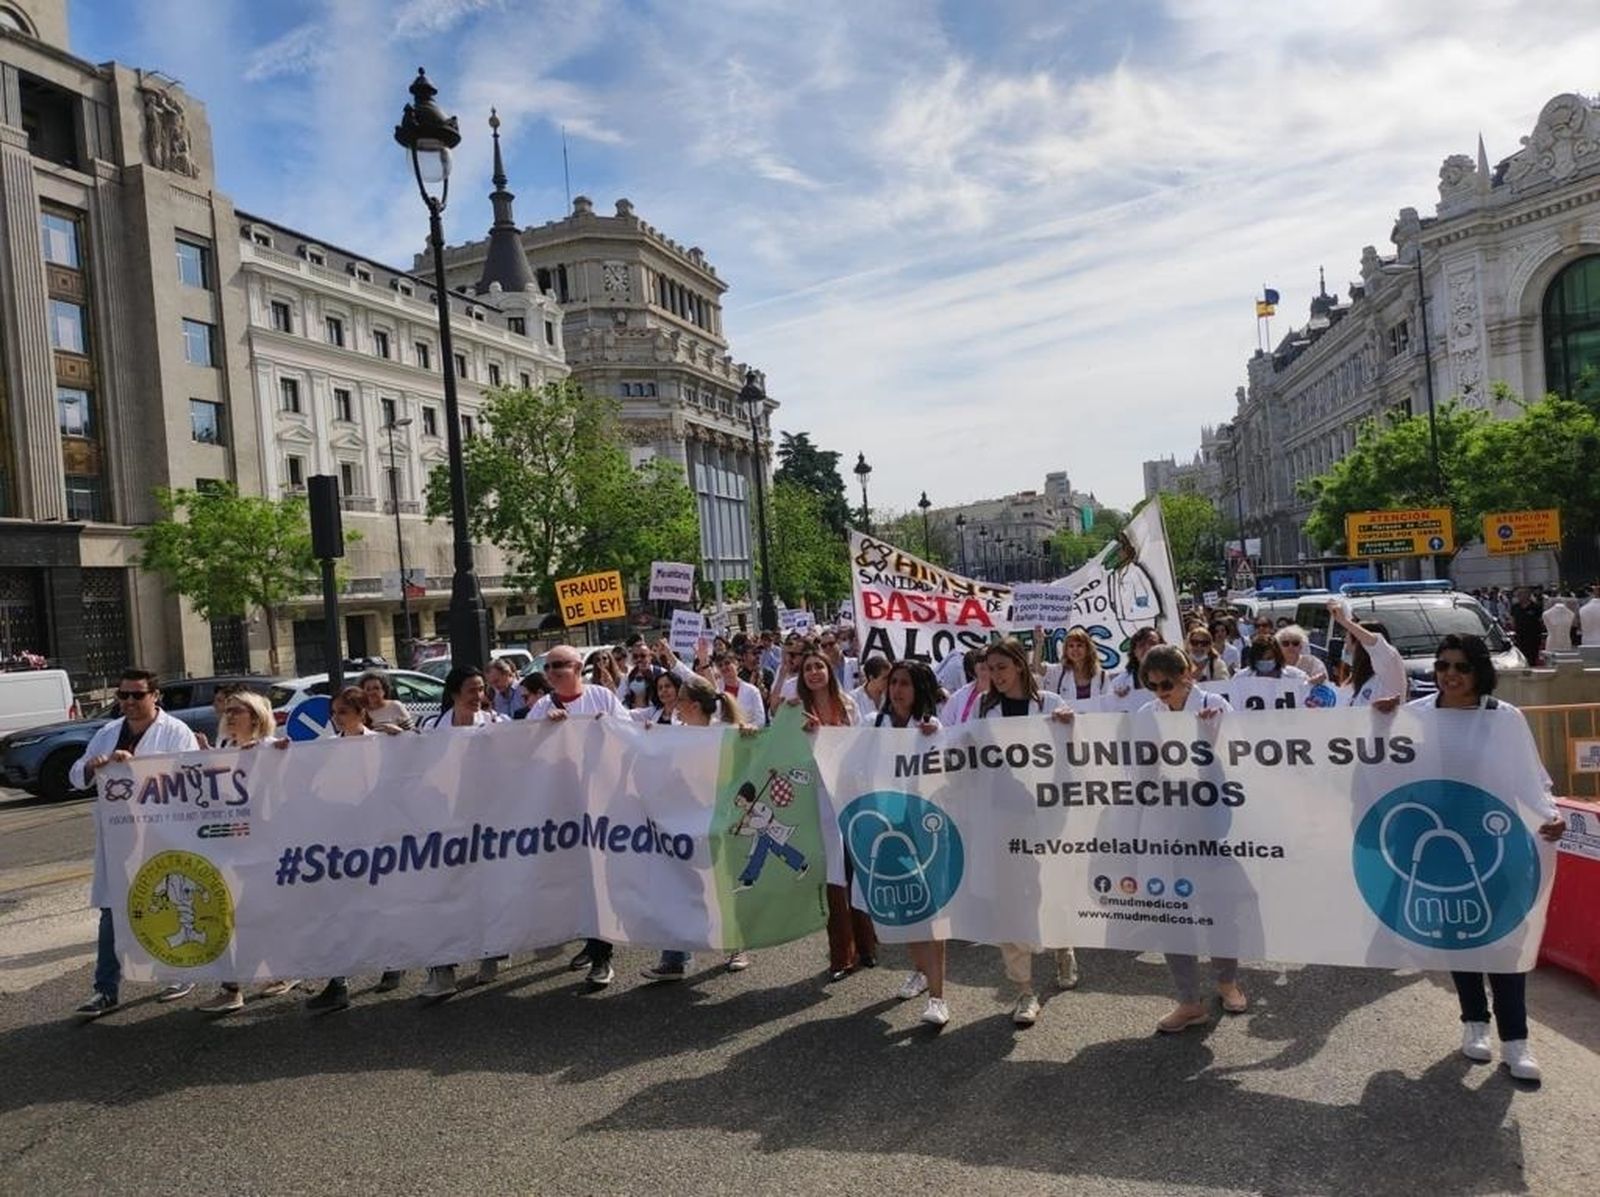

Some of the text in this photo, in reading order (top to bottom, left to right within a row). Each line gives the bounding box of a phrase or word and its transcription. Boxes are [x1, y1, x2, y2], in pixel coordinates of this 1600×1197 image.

[1369, 511, 1430, 522] ATENCIÓN
[560, 575, 618, 599] FRAUDE
[565, 603, 585, 620] DE
[861, 591, 995, 628] BASTA
[986, 599, 1002, 613] DE
[861, 626, 896, 665] A
[895, 736, 1417, 777] MÉDICOS UNIDOS POR SUS
[138, 763, 250, 808] AMYTS
[1036, 779, 1247, 809] DERECHOS
[275, 812, 694, 886] #StopMaltratoMedico
[1008, 838, 1285, 859] #LaVozdelaUniónMédica
[1099, 896, 1189, 910] @mudmedicos
[1077, 910, 1214, 926] www.mudmedicos.es
